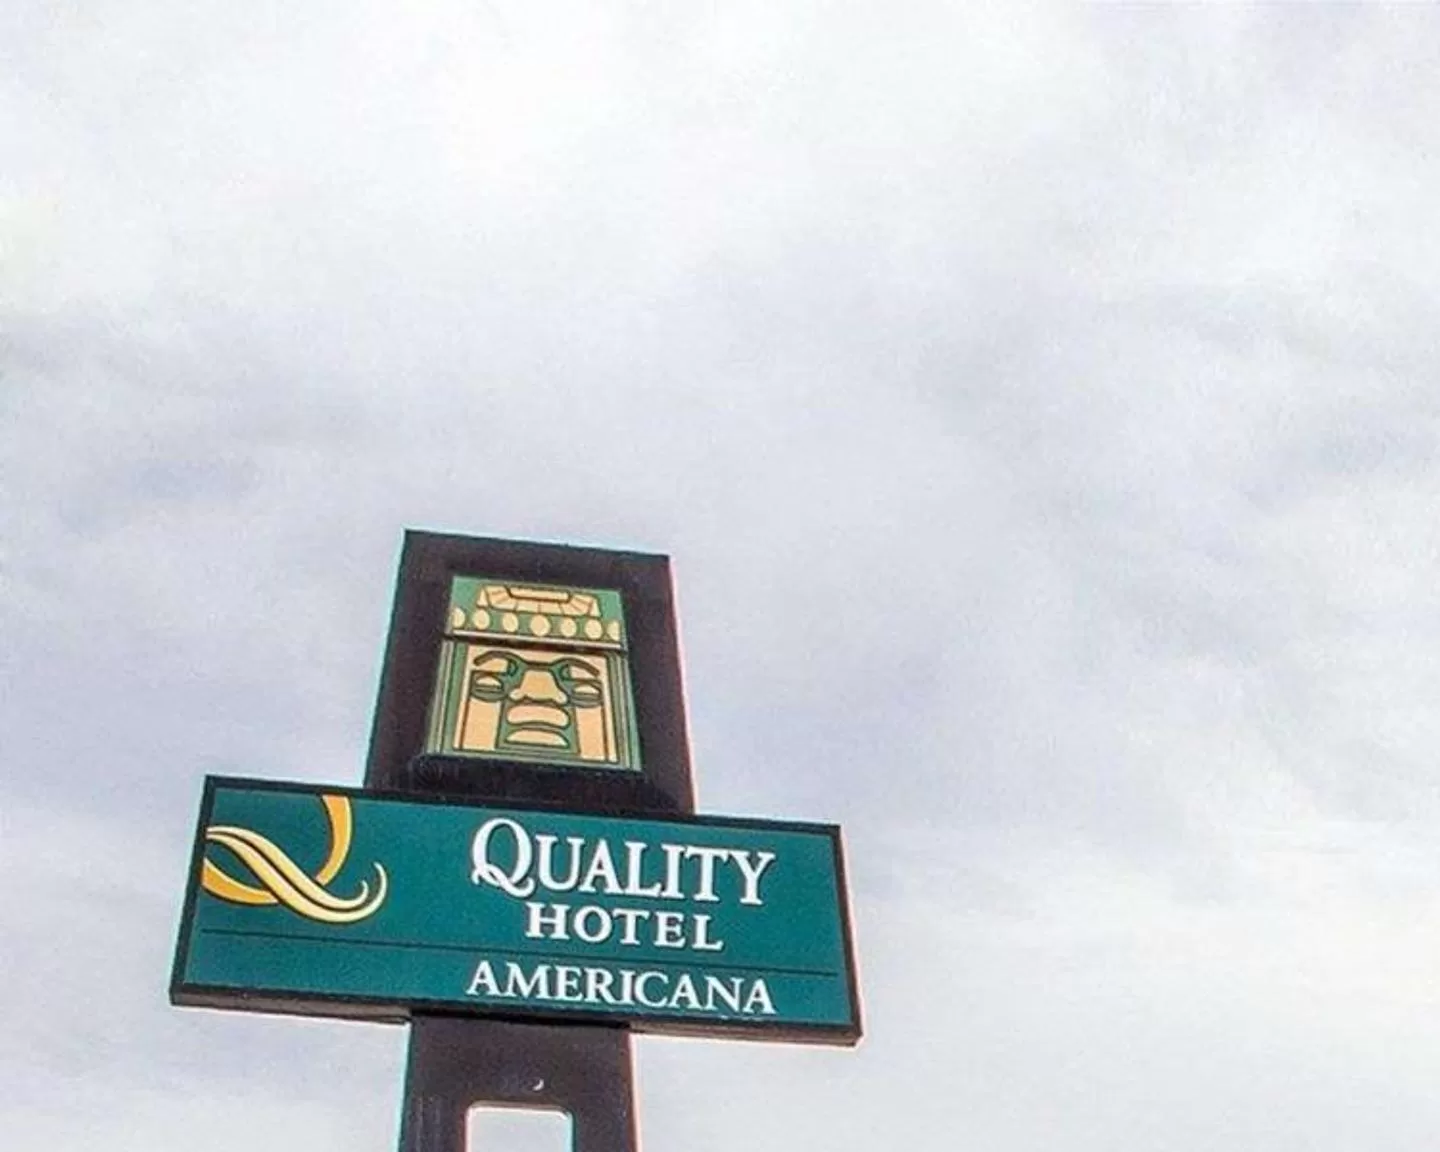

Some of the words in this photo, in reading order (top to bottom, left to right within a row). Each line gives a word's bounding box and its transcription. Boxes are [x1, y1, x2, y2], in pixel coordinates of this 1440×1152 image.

[470, 816, 776, 906] QUALITY
[524, 902, 723, 951] HOTEL
[466, 960, 777, 1014] AMERICANA
